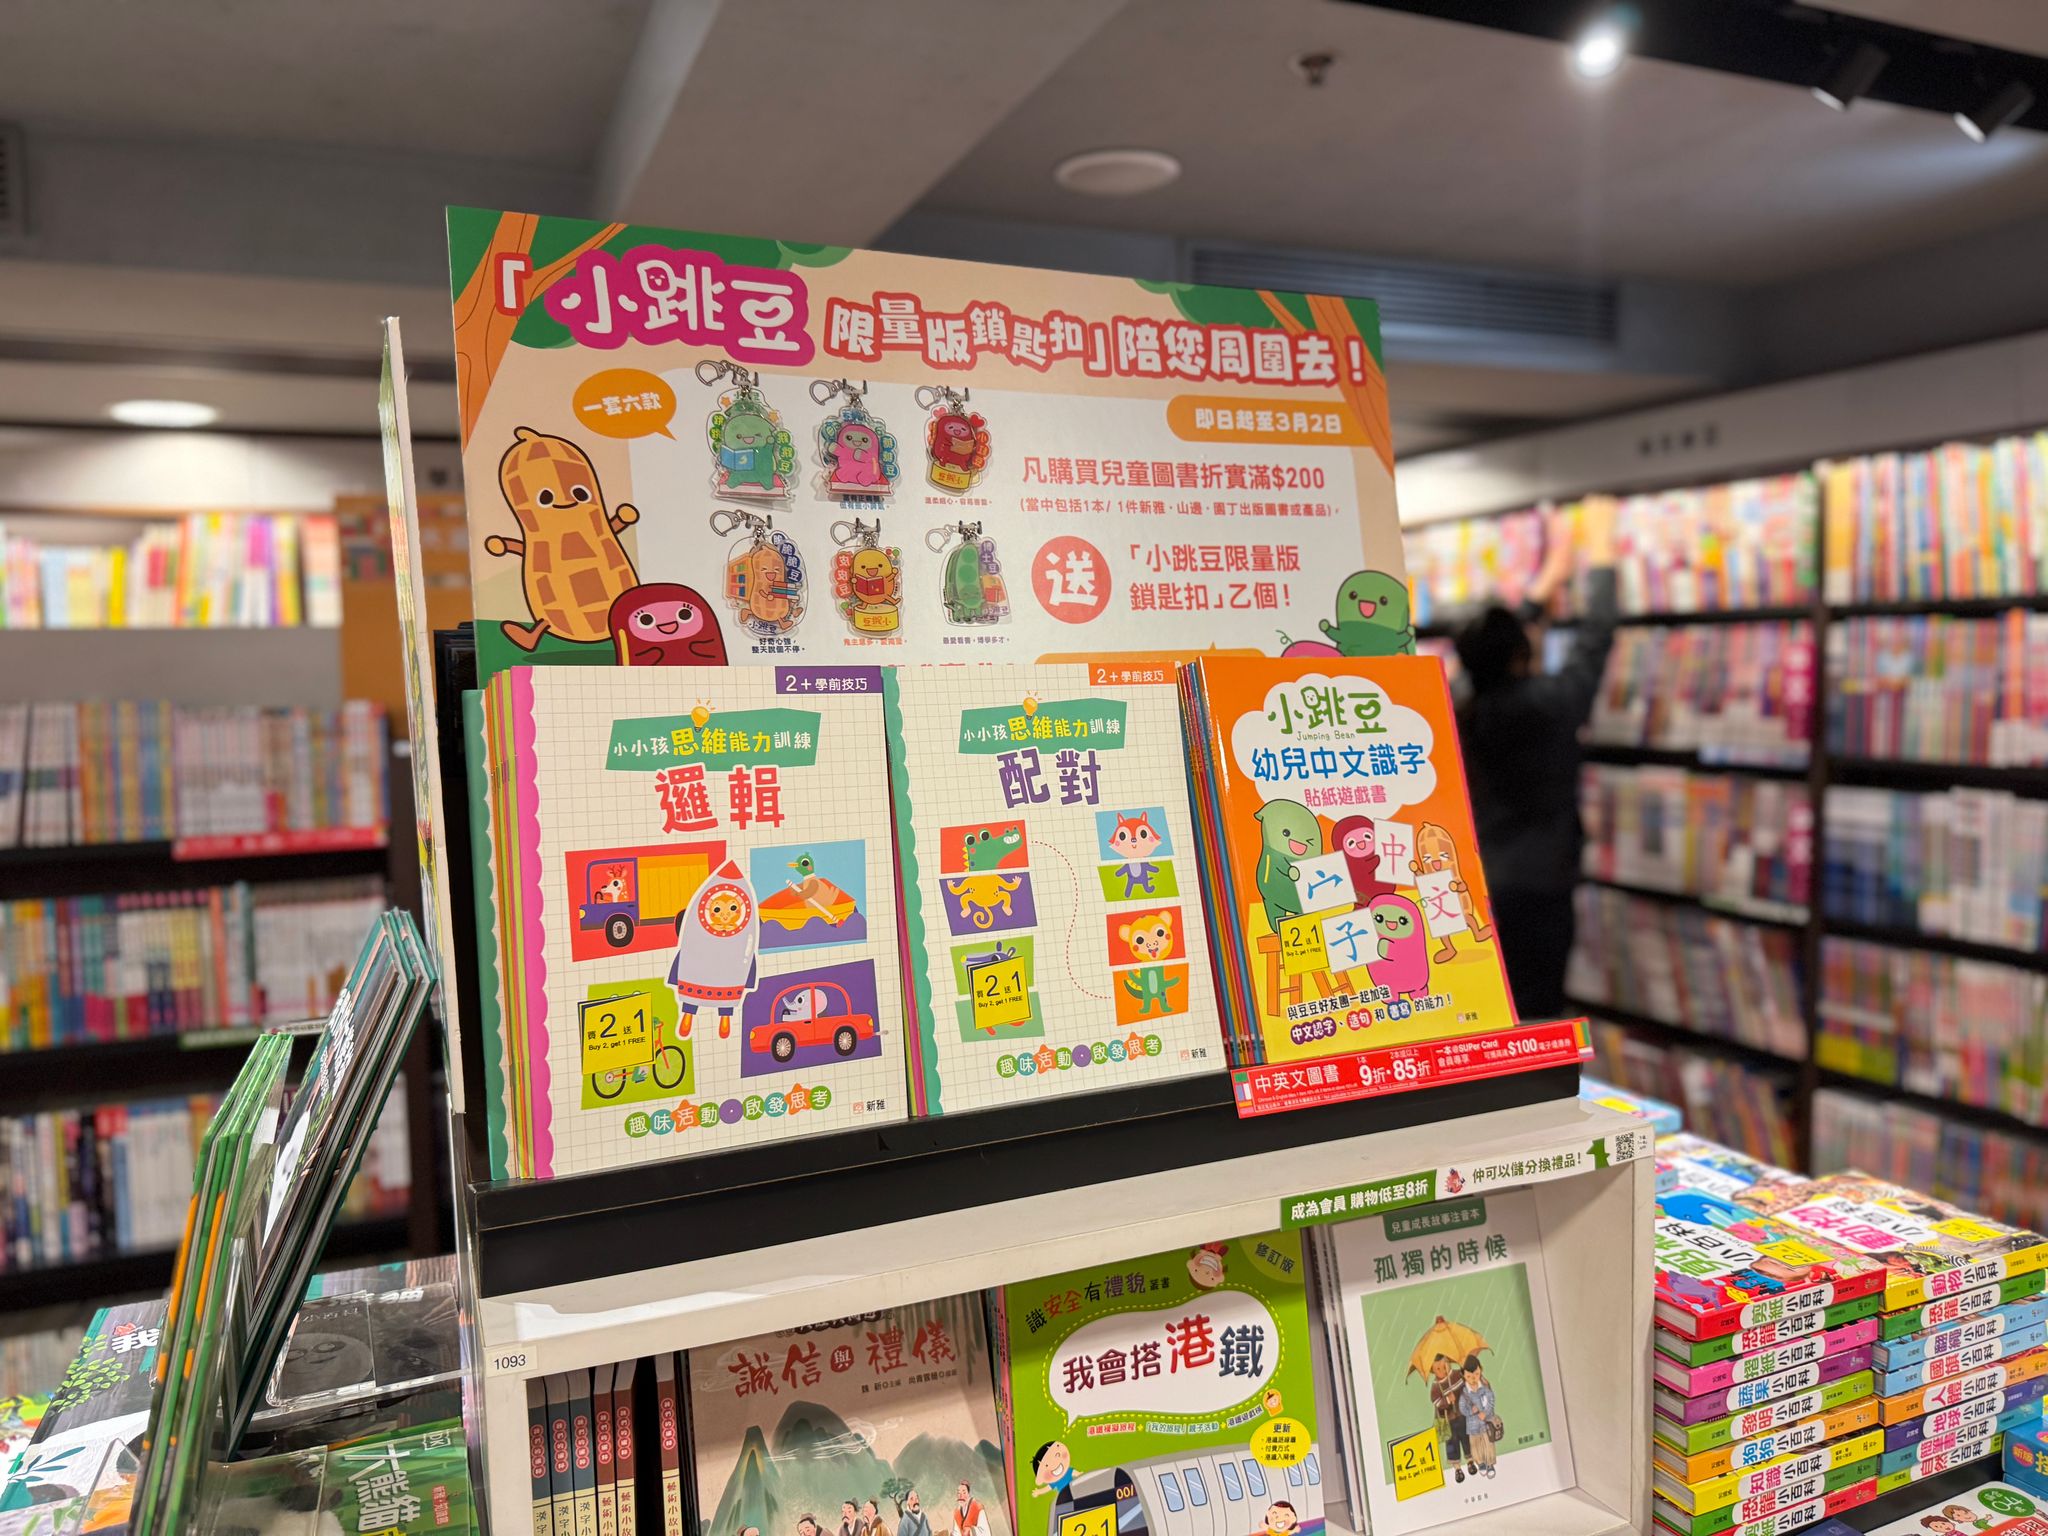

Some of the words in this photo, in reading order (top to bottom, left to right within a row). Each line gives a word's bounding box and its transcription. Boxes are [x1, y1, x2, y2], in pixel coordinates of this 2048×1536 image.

[583, 395, 662, 416] 一套六款
[1195, 408, 1342, 434] 即日起至3月2日
[1022, 456, 1325, 491] 凡購買兒童圖書折實滿$200
[1130, 543, 1301, 573] 「小跳豆限量版
[1045, 550, 1101, 607] 送
[1130, 582, 1291, 611] 鎖匙扣」乙個！
[815, 676, 868, 691] 學前技巧
[1121, 670, 1164, 682] 學前技巧
[1267, 686, 1387, 734] 小跳豆
[613, 727, 811, 758] 小小孩思維能力訓練
[963, 715, 1121, 742] 小小孩思維能力訓練
[1296, 730, 1330, 742] Jumping
[1334, 730, 1355, 740] Bean
[997, 749, 1101, 809] 配對
[1251, 743, 1425, 782] 幼兒中文識字
[655, 763, 785, 834] 邏輯
[1304, 785, 1388, 807] 貼紙遊戲書
[1382, 833, 1406, 875] 中
[1429, 885, 1460, 921] 文
[1329, 920, 1369, 962] 子
[1009, 995, 1023, 1003] FREE
[1288, 985, 1391, 1020] 與豆豆好友團一起加強
[588, 1043, 603, 1052] Buy
[611, 1040, 621, 1049] get
[628, 1036, 646, 1045] FREE
[1190, 1048, 1207, 1059] 新雅
[1481, 1040, 1498, 1049] Card
[1255, 1064, 1339, 1094] 中英文圖書
[866, 1100, 886, 1112] 新雅
[1472, 1152, 1581, 1184] 仲可以儲分換禮品！
[1291, 1193, 1346, 1220] 成為會員
[1350, 1180, 1428, 1210] 購物低至8折
[1391, 1208, 1480, 1235] 兒童成長故事注音本
[1255, 1242, 1295, 1274] 修訂版
[1373, 1234, 1508, 1284] 孤獨的時候
[1931, 1262, 1998, 1297] 動物小百科
[1026, 1271, 1170, 1334] 識安全有禮貌叢書
[1752, 1289, 1825, 1324] 剪紙小百科
[1929, 1289, 1993, 1324] 恐龍小百科
[1742, 1312, 1816, 1350] 恐龍小百科
[494, 1354, 526, 1370] 1093
[728, 1319, 956, 1397] 誠信與禮儀
[1063, 1314, 1264, 1394] 我會搭港鐵
[1930, 1344, 1994, 1378] 國旗小百科
[1738, 1369, 1810, 1407] 蔬果小百科
[1932, 1372, 1998, 1405] 人體小百科
[1273, 1423, 1291, 1434] 更新
[1742, 1396, 1813, 1435] 發明小百科
[1933, 1397, 1997, 1433] 地球小百科
[427, 1432, 450, 1448] DK
[1743, 1426, 1815, 1465] 狗狗小百科
[1750, 1455, 1822, 1493] 知識小百科
[1921, 1441, 1983, 1476] 自然小百科
[344, 1445, 420, 1532] 大熊貓
[1742, 1476, 1815, 1516] 恐龍小百科
[602, 1497, 613, 1536] 藝術小
